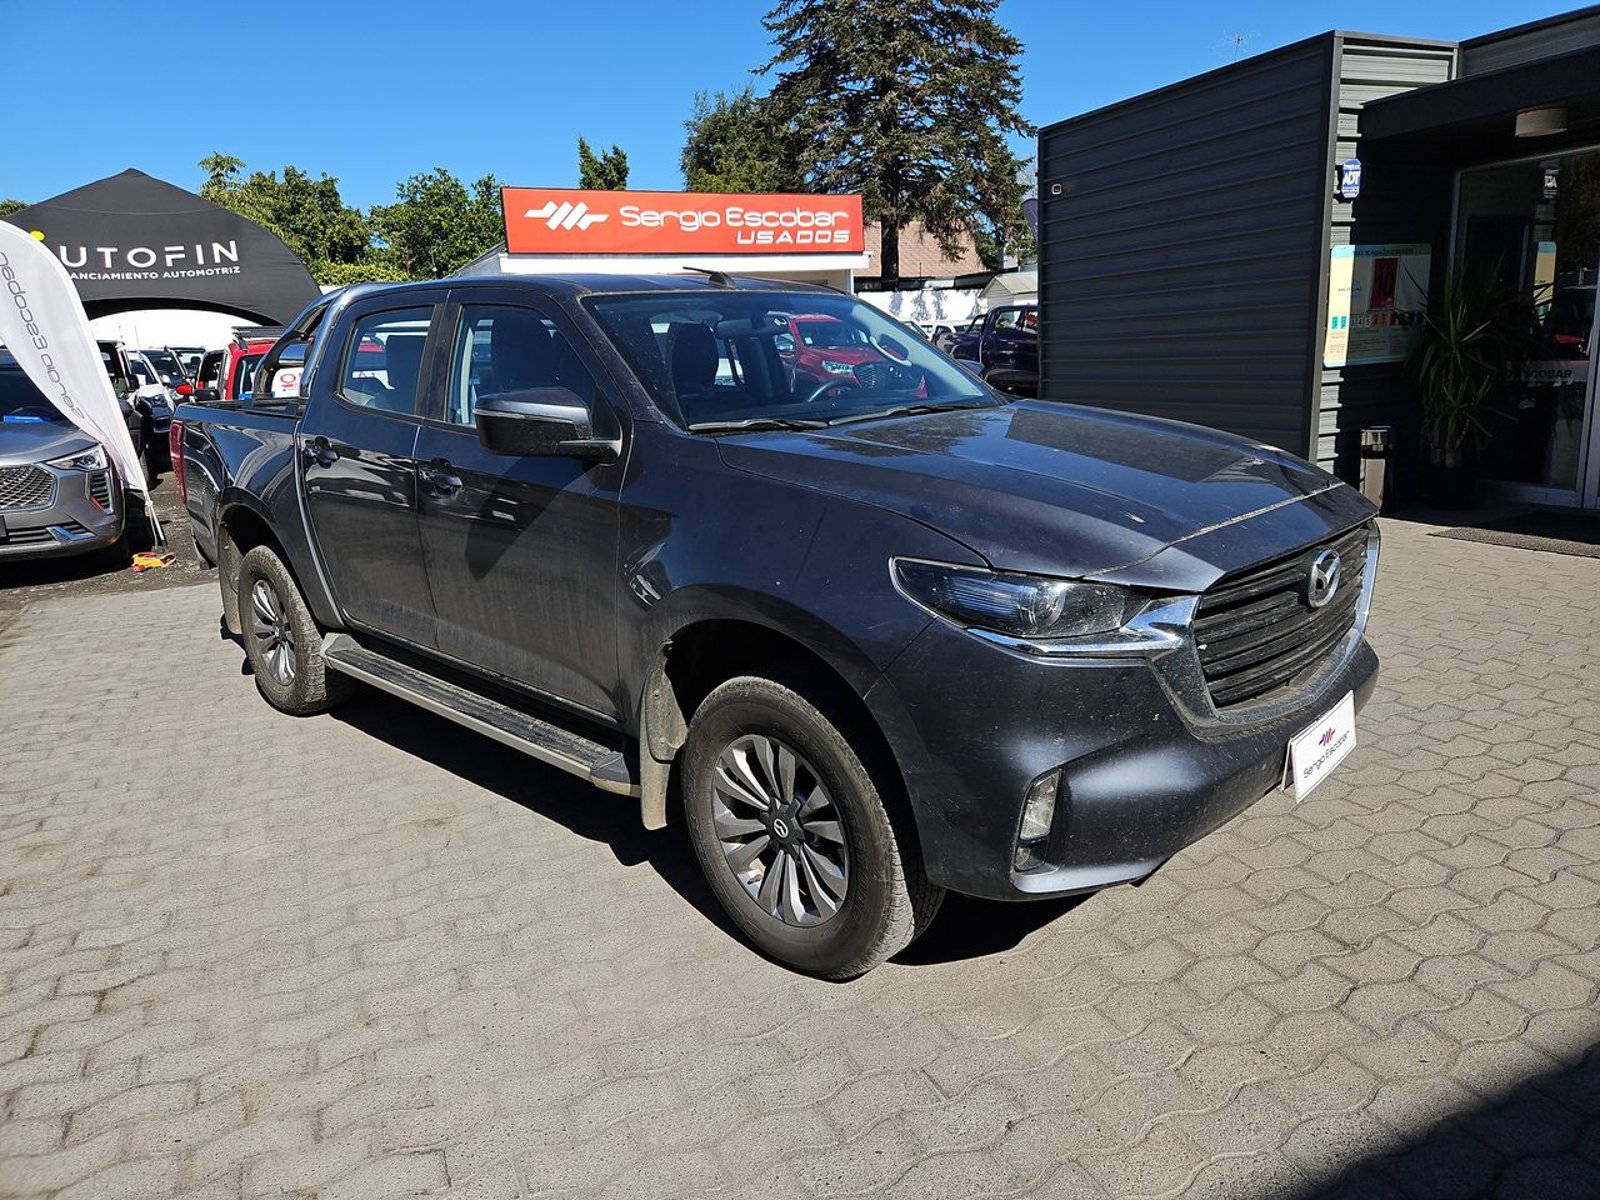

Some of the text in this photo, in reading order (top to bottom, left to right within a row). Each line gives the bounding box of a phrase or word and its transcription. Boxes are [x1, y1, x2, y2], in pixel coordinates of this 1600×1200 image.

[1342, 171, 1361, 186] ADT
[620, 205, 849, 232] Sergio Escobar
[736, 230, 851, 244] USADOS
[59, 240, 240, 268] UTOFIN
[70, 266, 241, 281] ANCIAMIENTO AUTOMOTRIZ
[1303, 730, 1350, 778] Sergio Escobar
